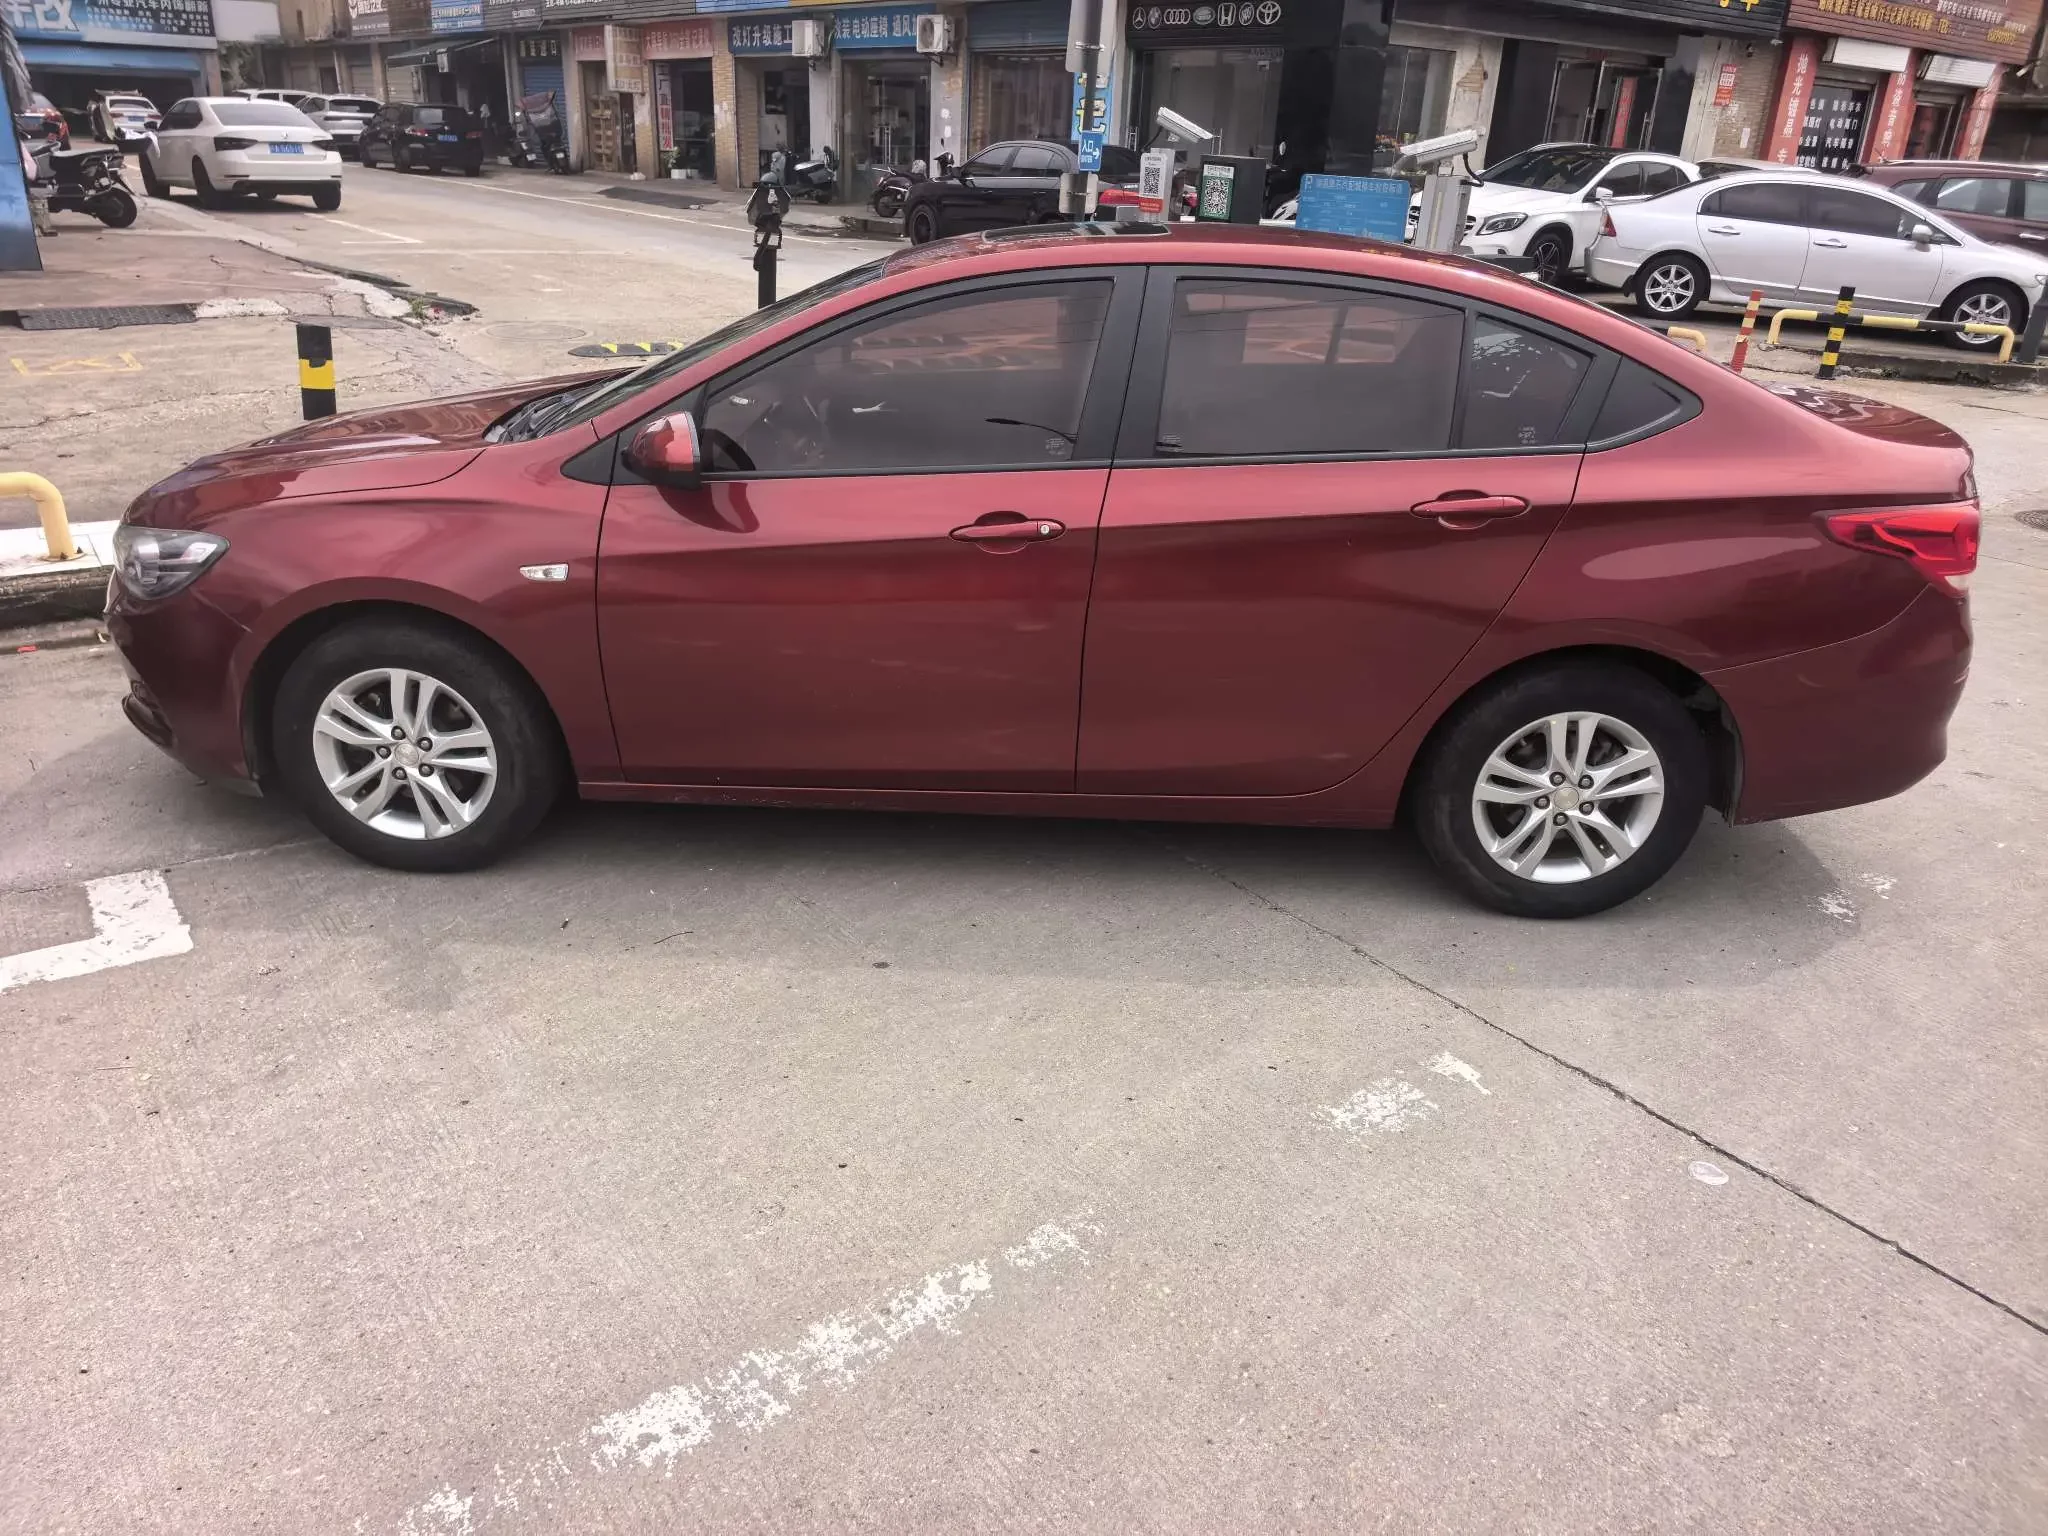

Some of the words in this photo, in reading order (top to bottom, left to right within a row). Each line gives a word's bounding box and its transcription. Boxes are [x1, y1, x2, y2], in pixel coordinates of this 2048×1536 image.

[732, 23, 792, 48] 改灯升级施工
